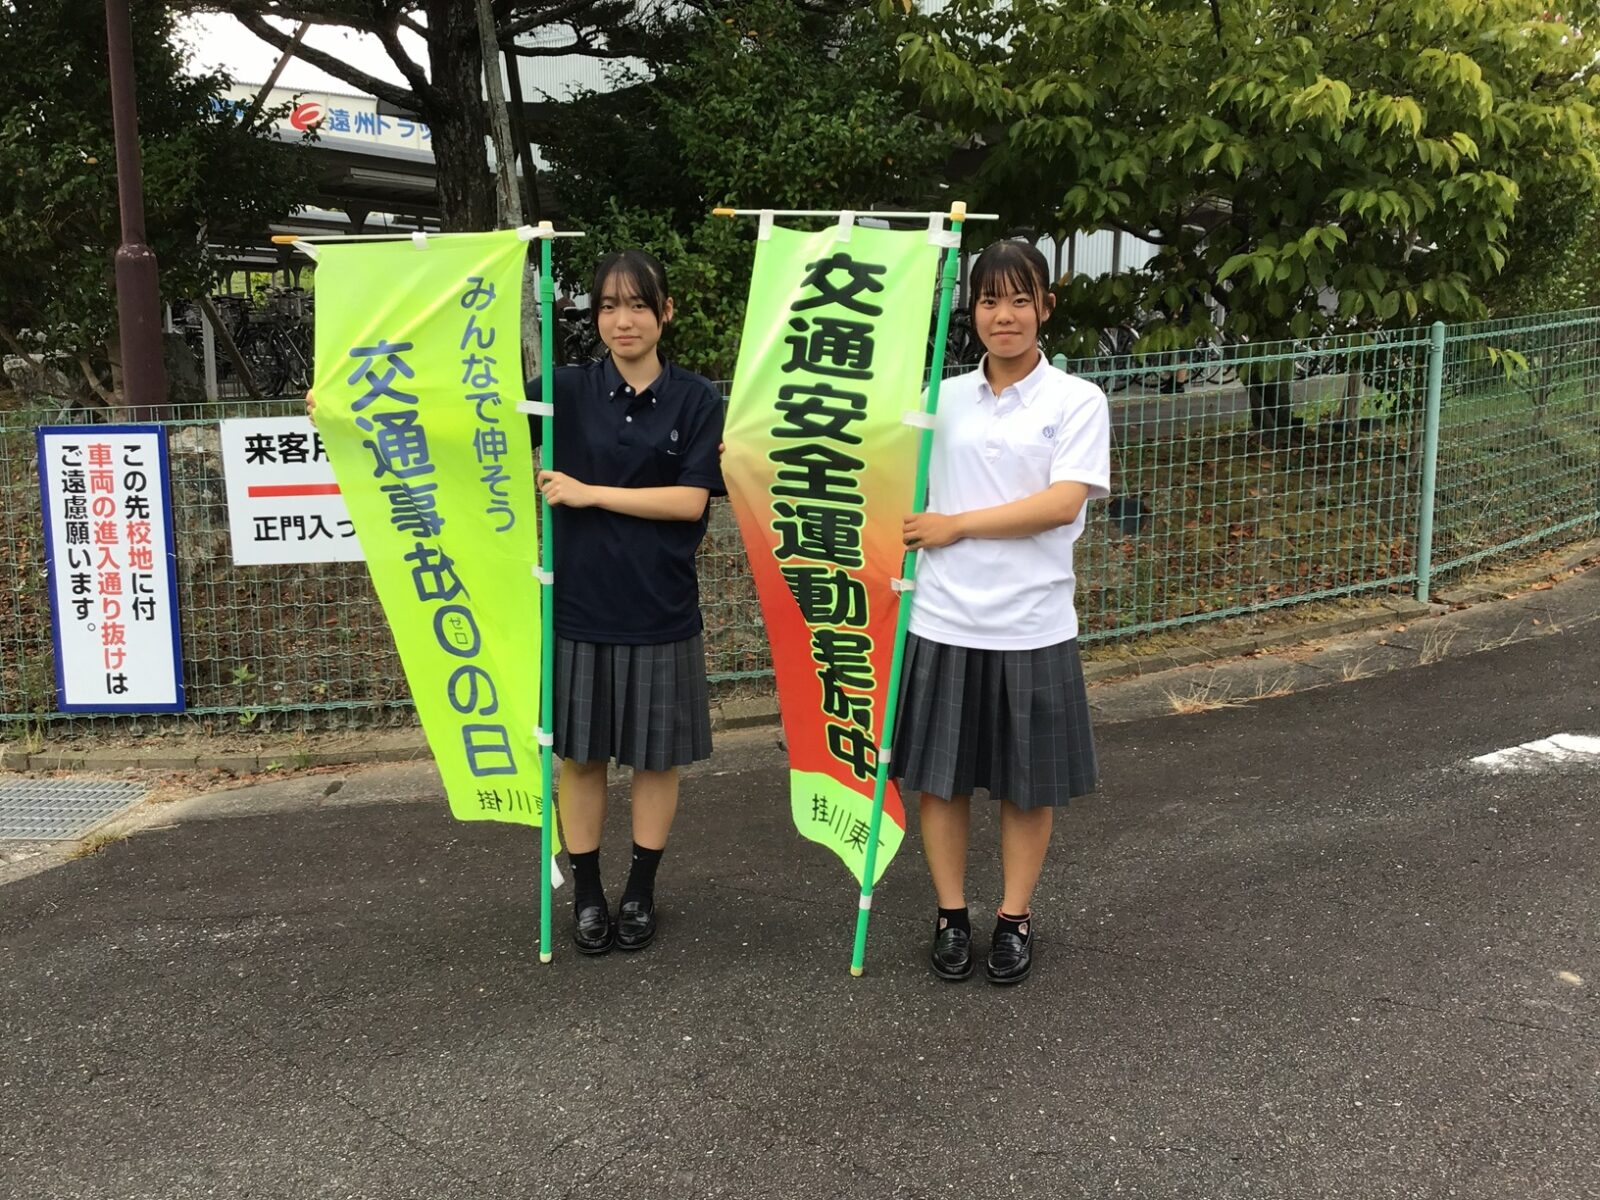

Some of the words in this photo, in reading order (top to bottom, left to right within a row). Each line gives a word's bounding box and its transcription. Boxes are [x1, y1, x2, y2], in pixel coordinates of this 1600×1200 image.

[460, 276, 515, 533] みんなで伸そう
[61, 444, 97, 632] ご遠慮願います。
[87, 442, 129, 695] 車両の進入通り抜けは
[122, 444, 156, 621] この先校地に付
[812, 793, 885, 854] 掛川東
